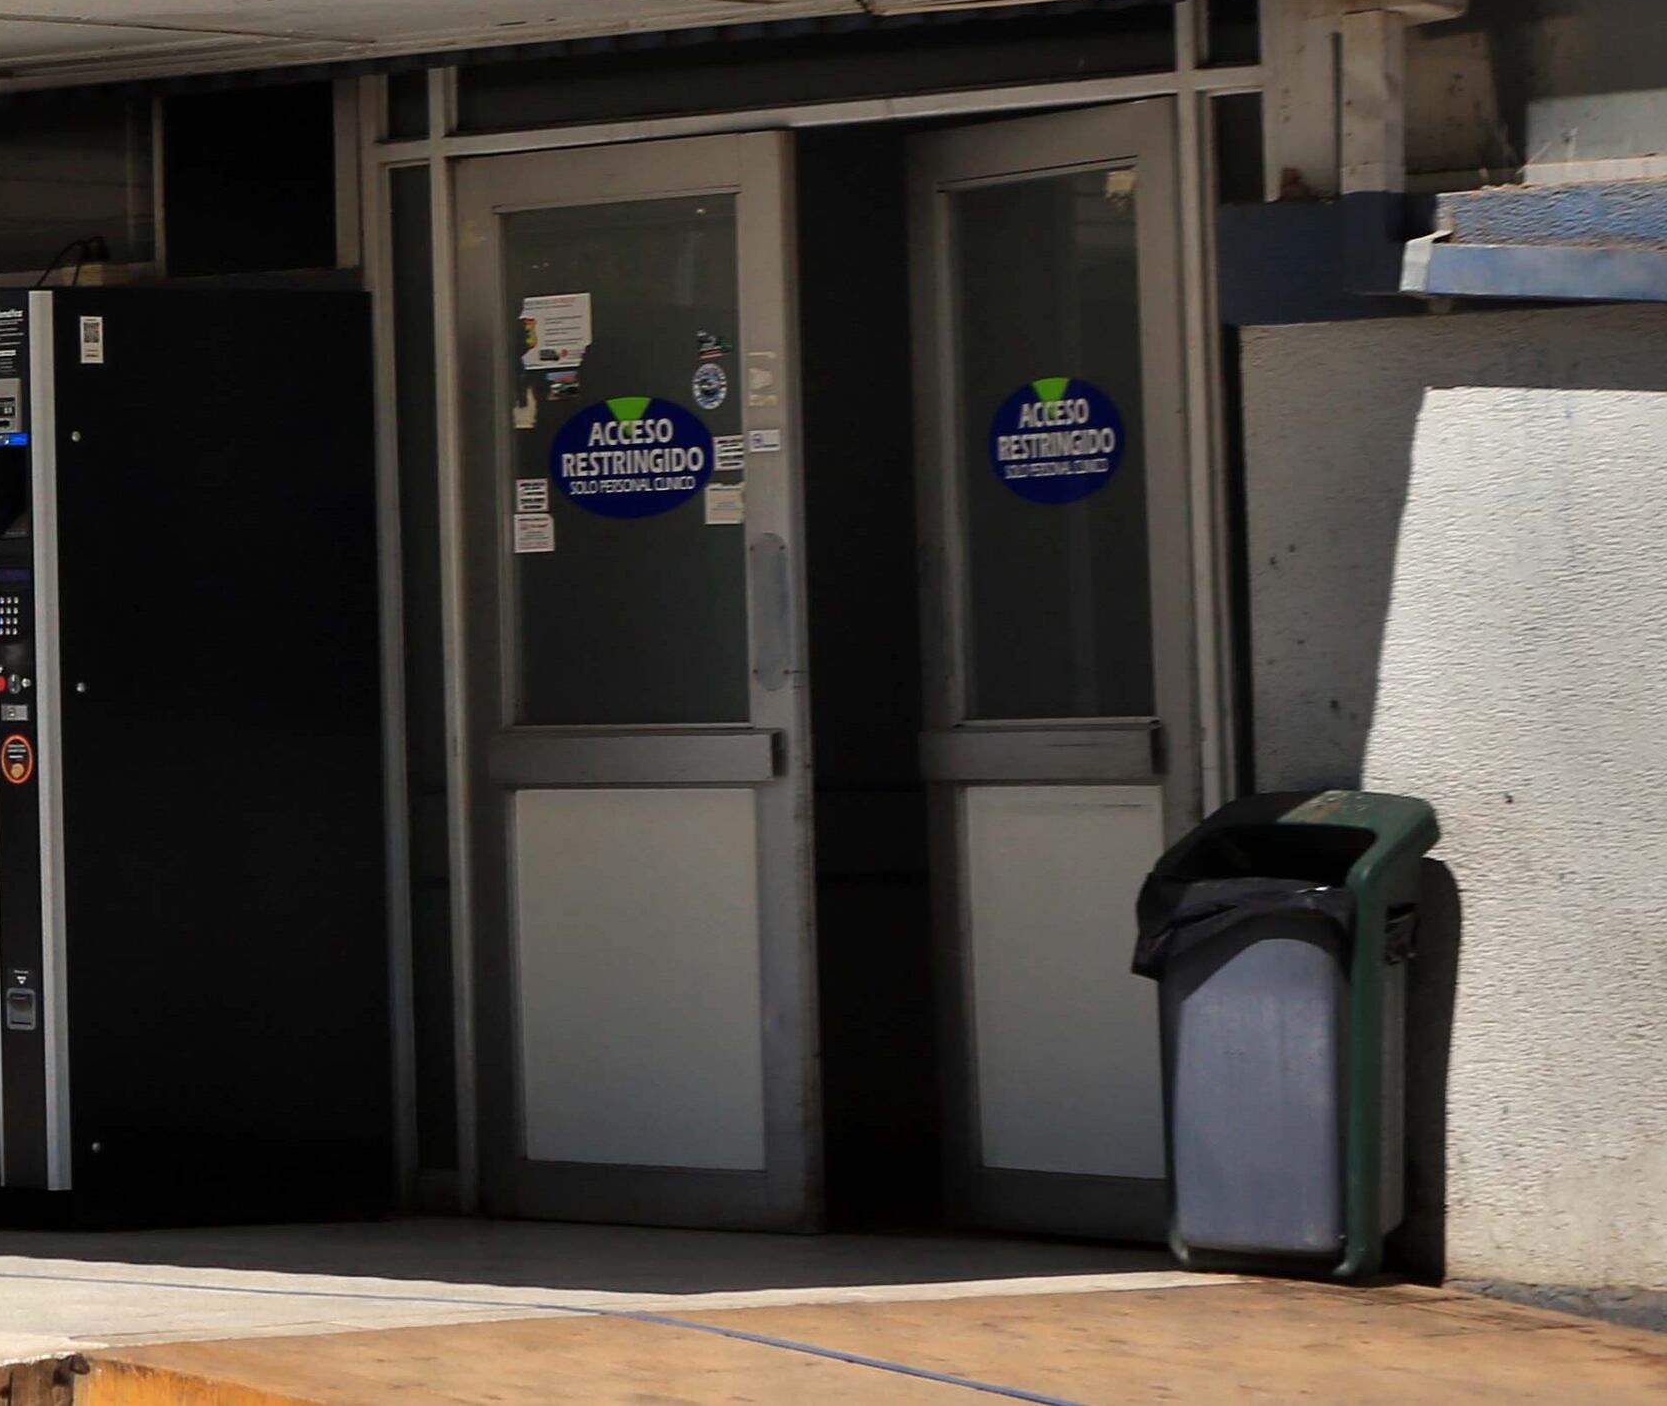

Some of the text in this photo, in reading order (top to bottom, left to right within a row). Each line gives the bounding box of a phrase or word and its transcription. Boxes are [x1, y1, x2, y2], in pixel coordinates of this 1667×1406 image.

[1017, 397, 1090, 430] ACCESO
[587, 417, 674, 448] ACCESO
[996, 427, 1117, 462] RESTRINGIDO
[561, 446, 706, 478] RESTRINGIDO
[569, 480, 599, 495] SOLO
[599, 478, 653, 494] PERSONAL
